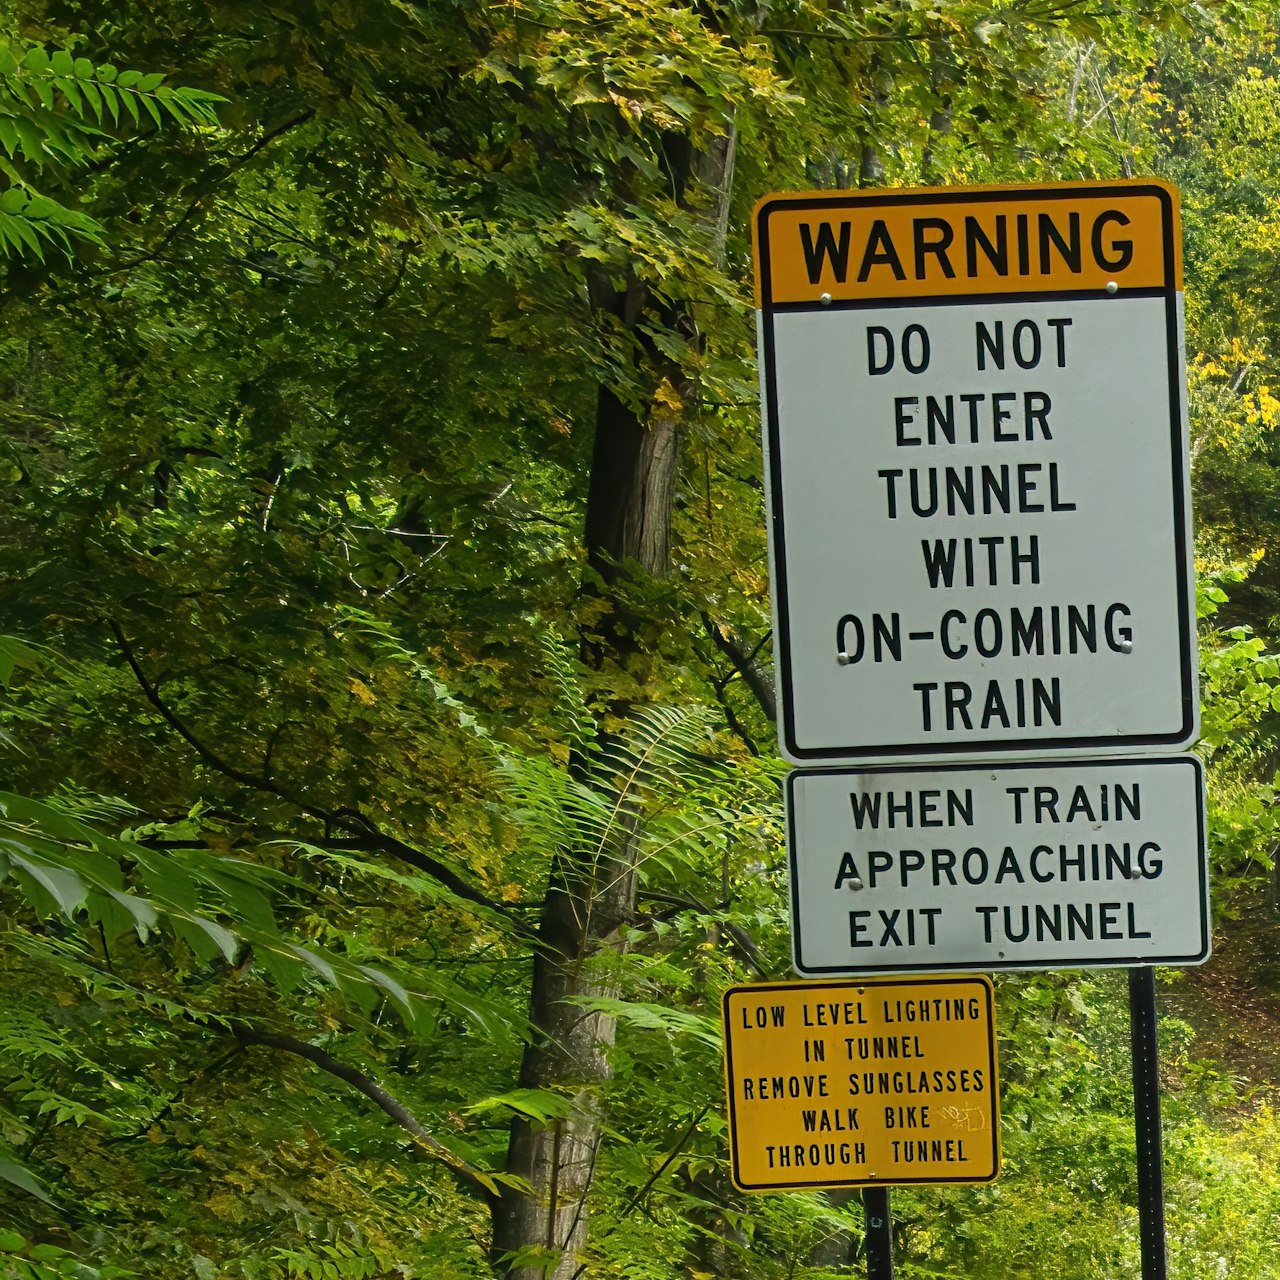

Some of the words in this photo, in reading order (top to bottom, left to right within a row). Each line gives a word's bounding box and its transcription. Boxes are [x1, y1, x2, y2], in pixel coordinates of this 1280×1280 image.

[799, 211, 1133, 285] WARNING
[867, 324, 930, 375] DO
[976, 318, 1073, 370] NOT
[894, 392, 1052, 446] ENTER
[878, 463, 1076, 518] TUNNEL
[921, 535, 1039, 588] WITH
[837, 603, 1132, 664] ON-COMING
[913, 678, 1061, 732] TRAIN
[850, 789, 973, 829] WHEN
[1006, 784, 1140, 824] TRAIN
[834, 842, 1162, 889] APPROACHING
[849, 908, 942, 947] EXIT
[976, 902, 1151, 943] TUNNEL
[742, 1006, 785, 1029] LOW
[803, 1003, 868, 1027] LEVEL
[884, 998, 980, 1022] LIGHTING
[804, 1039, 825, 1062] IN
[844, 1035, 925, 1060] TUNNEL
[743, 1075, 830, 1100] REMOVE
[848, 1070, 985, 1094] SUNGLASSES
[802, 1108, 859, 1132] WALK
[884, 1106, 930, 1129] BIKE
[766, 1142, 866, 1168] THROUGH
[892, 1139, 968, 1163] TUNNEL
